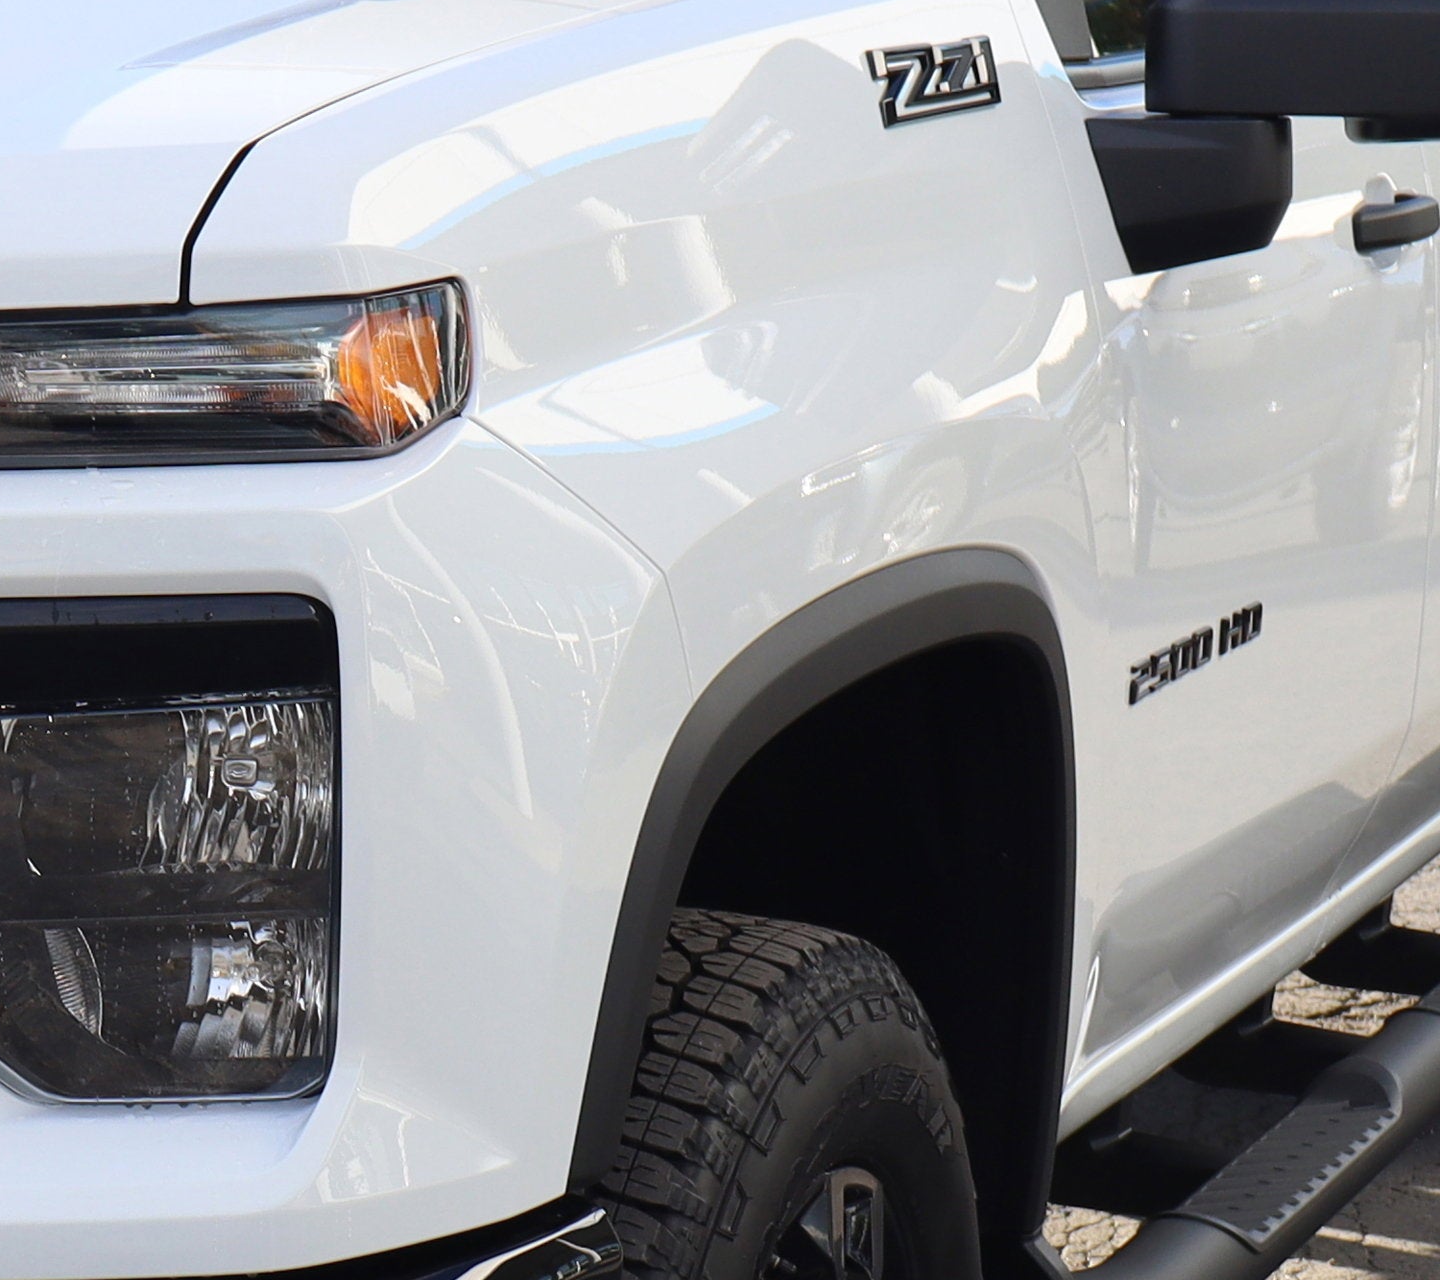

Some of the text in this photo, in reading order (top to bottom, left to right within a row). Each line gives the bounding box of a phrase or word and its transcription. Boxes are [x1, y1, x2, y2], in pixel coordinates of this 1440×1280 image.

[862, 34, 1002, 129] Z71
[1128, 600, 1263, 706] 2500 HD
